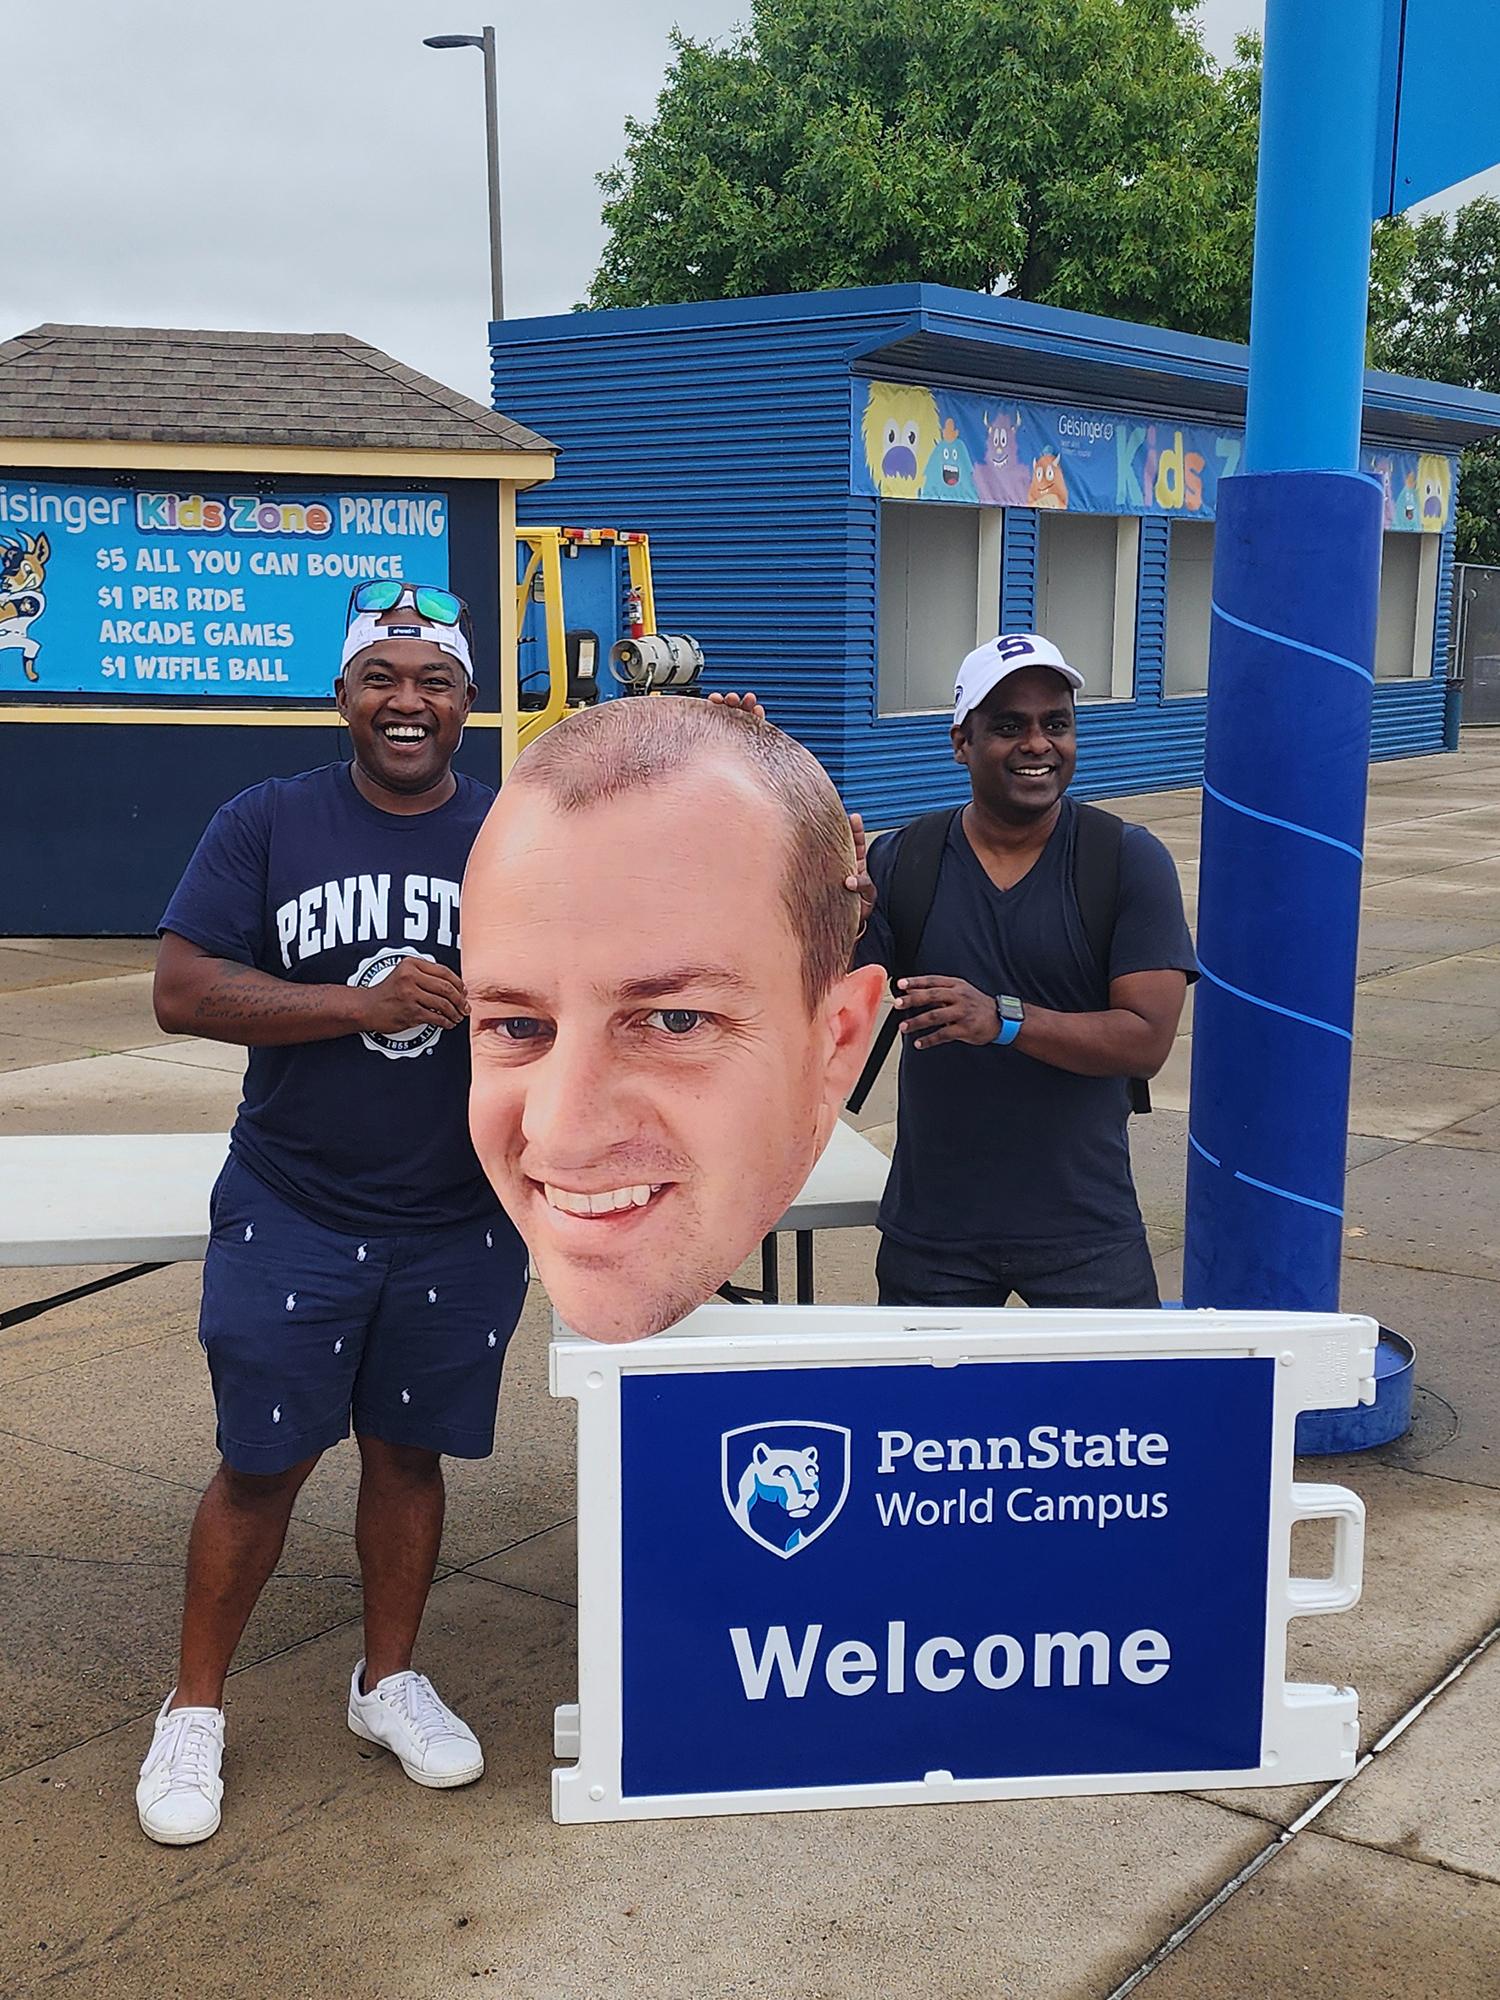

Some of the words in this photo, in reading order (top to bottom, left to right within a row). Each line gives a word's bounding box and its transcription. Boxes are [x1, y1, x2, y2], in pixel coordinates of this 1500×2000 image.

[1058, 414, 1104, 444] Geisinger
[1115, 424, 1205, 512] Kids
[138, 493, 225, 531] Kids
[230, 496, 332, 534] Zone
[339, 497, 445, 537] PRICING
[96, 547, 127, 572] $5
[135, 548, 181, 573] ALL
[187, 550, 241, 575] YOU
[250, 552, 298, 576] CAN
[307, 553, 404, 578] BOUNCE
[98, 586, 123, 608] $1
[132, 586, 179, 610] PER
[187, 587, 246, 612] RIDE
[99, 619, 196, 645] ARCADE
[204, 622, 294, 647] GAMES
[101, 656, 126, 677] $1
[134, 655, 220, 680] WIFFLE
[228, 657, 288, 682] BALL
[276, 874, 391, 970] PENN
[404, 874, 461, 950] ST
[877, 1426, 1169, 1473] PennState
[875, 1488, 994, 1526] World
[1007, 1488, 1168, 1528] Campus
[729, 1621, 1171, 1700] Welcome
